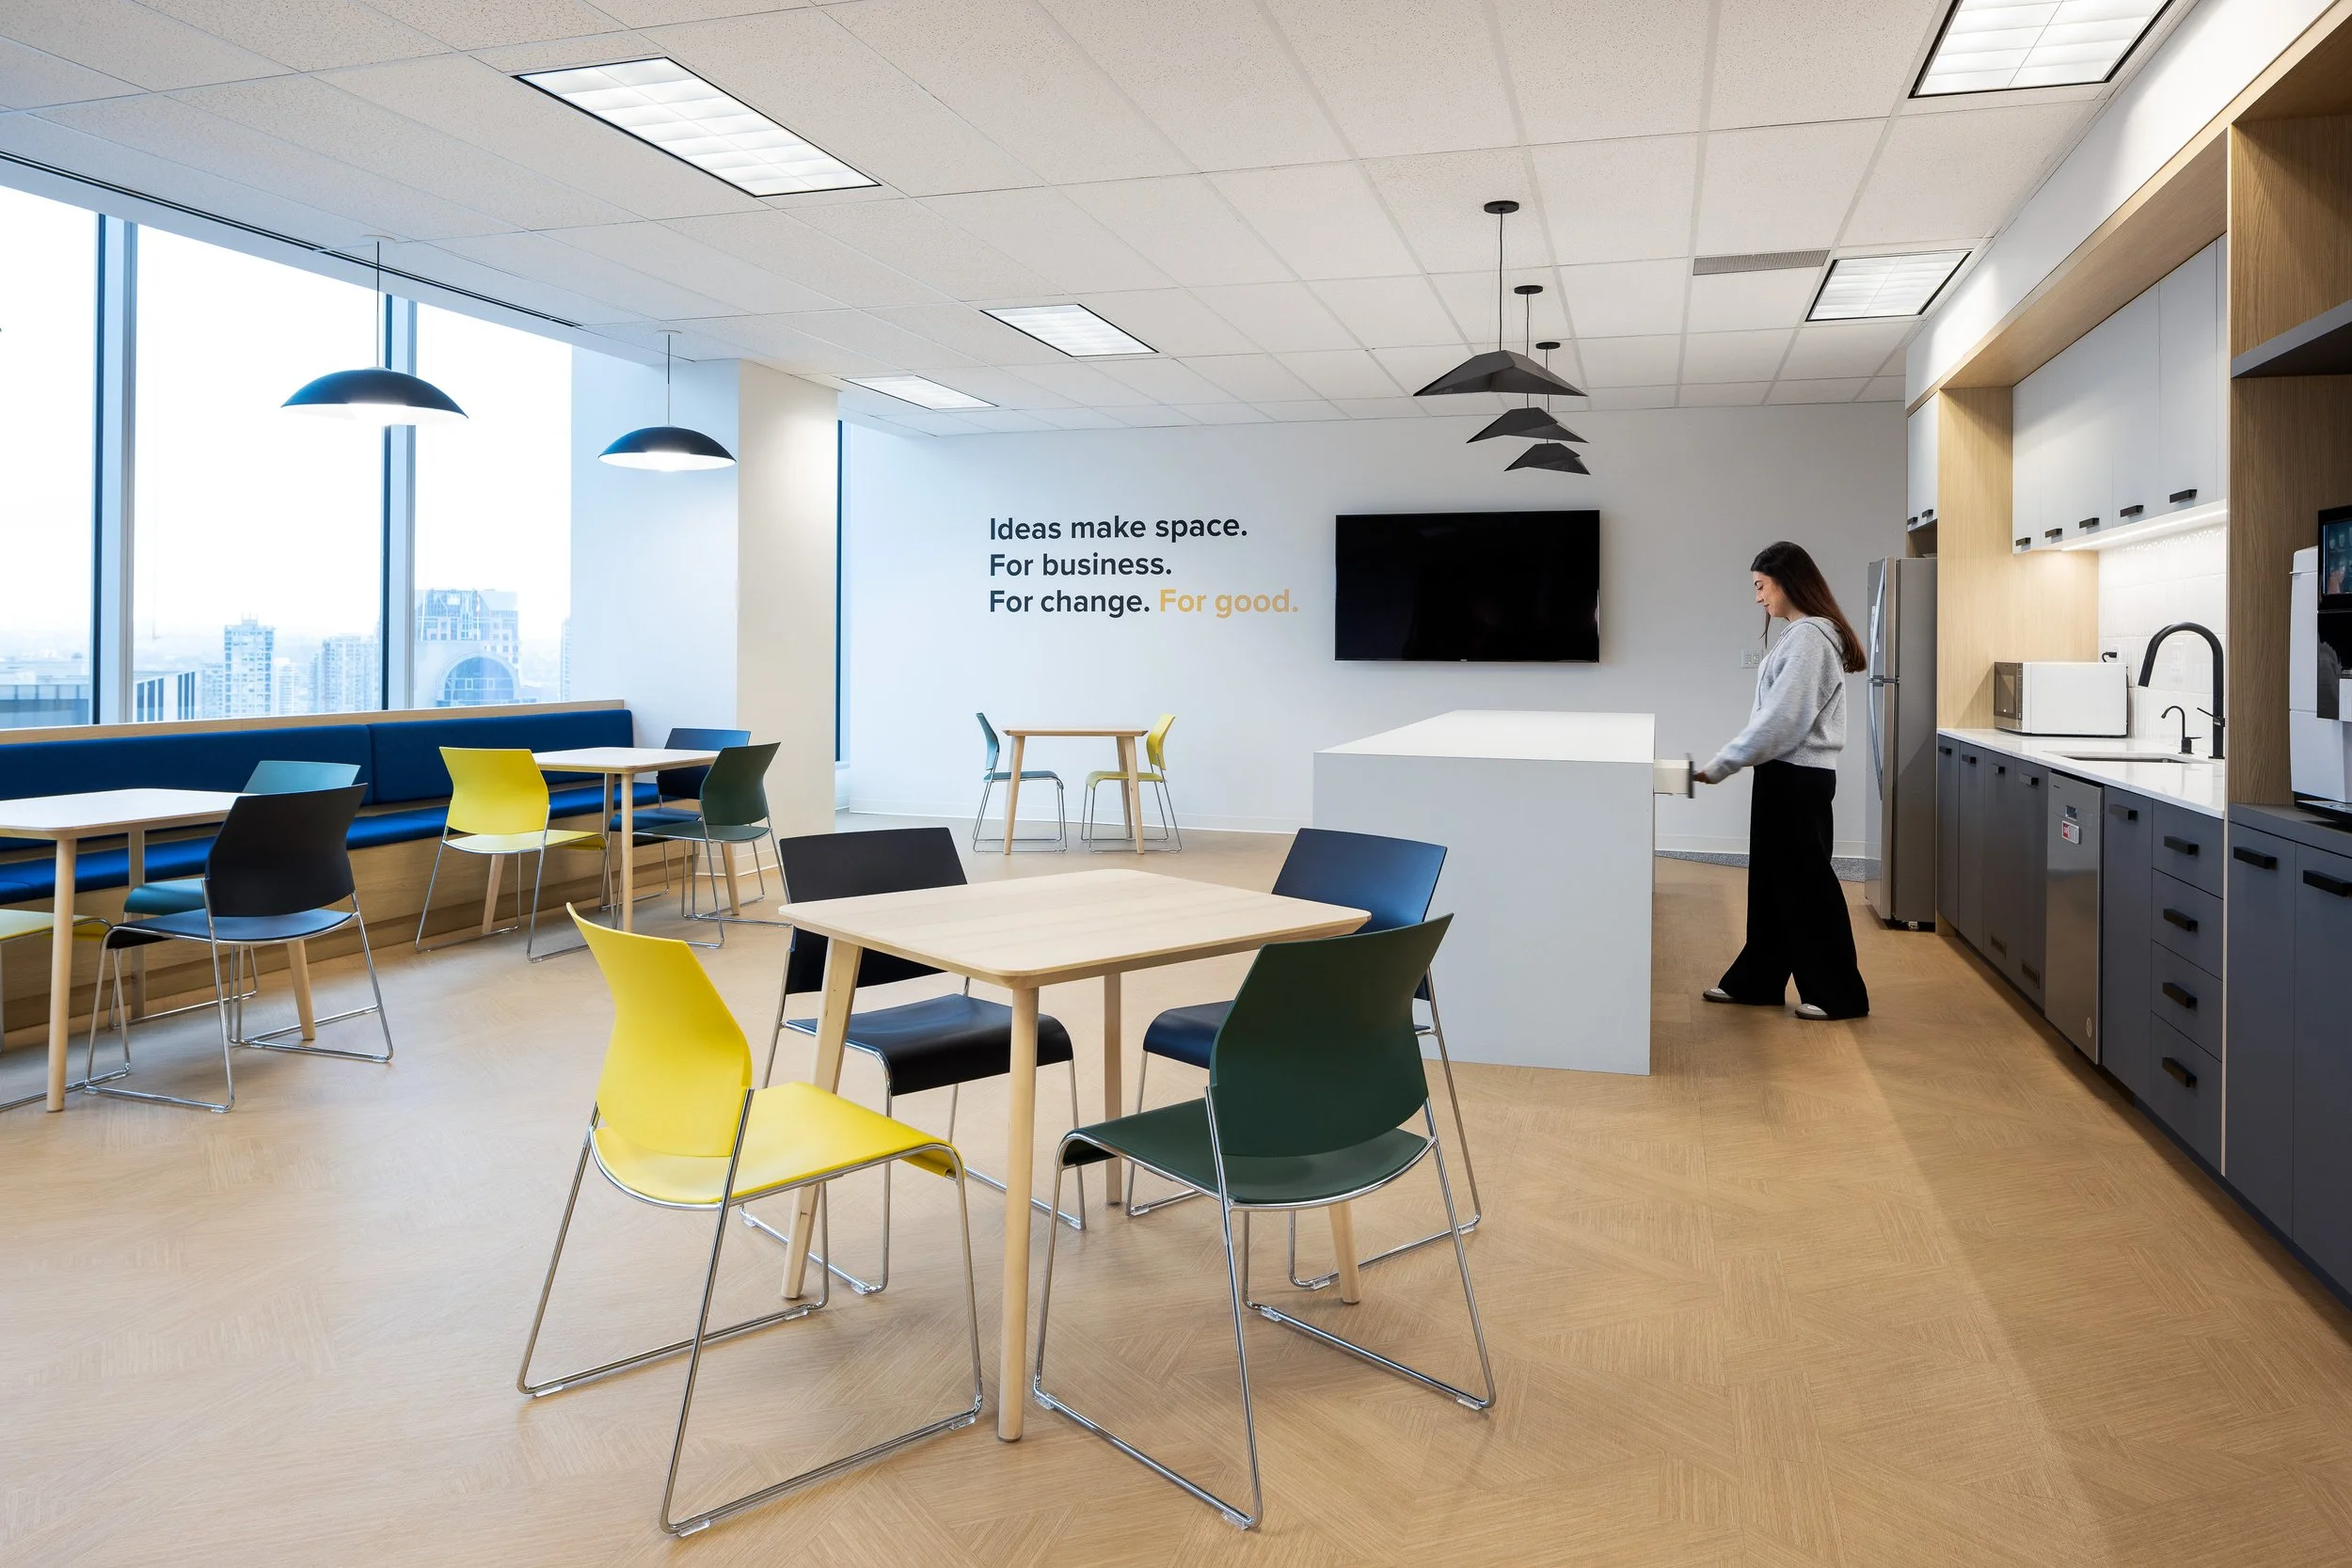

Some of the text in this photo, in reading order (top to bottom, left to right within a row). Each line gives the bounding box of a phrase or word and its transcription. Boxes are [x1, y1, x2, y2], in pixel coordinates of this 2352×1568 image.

[990, 515, 1248, 544] Ideas make space.
[990, 551, 1172, 577] For business.
[990, 588, 1298, 619] For change. For good.
